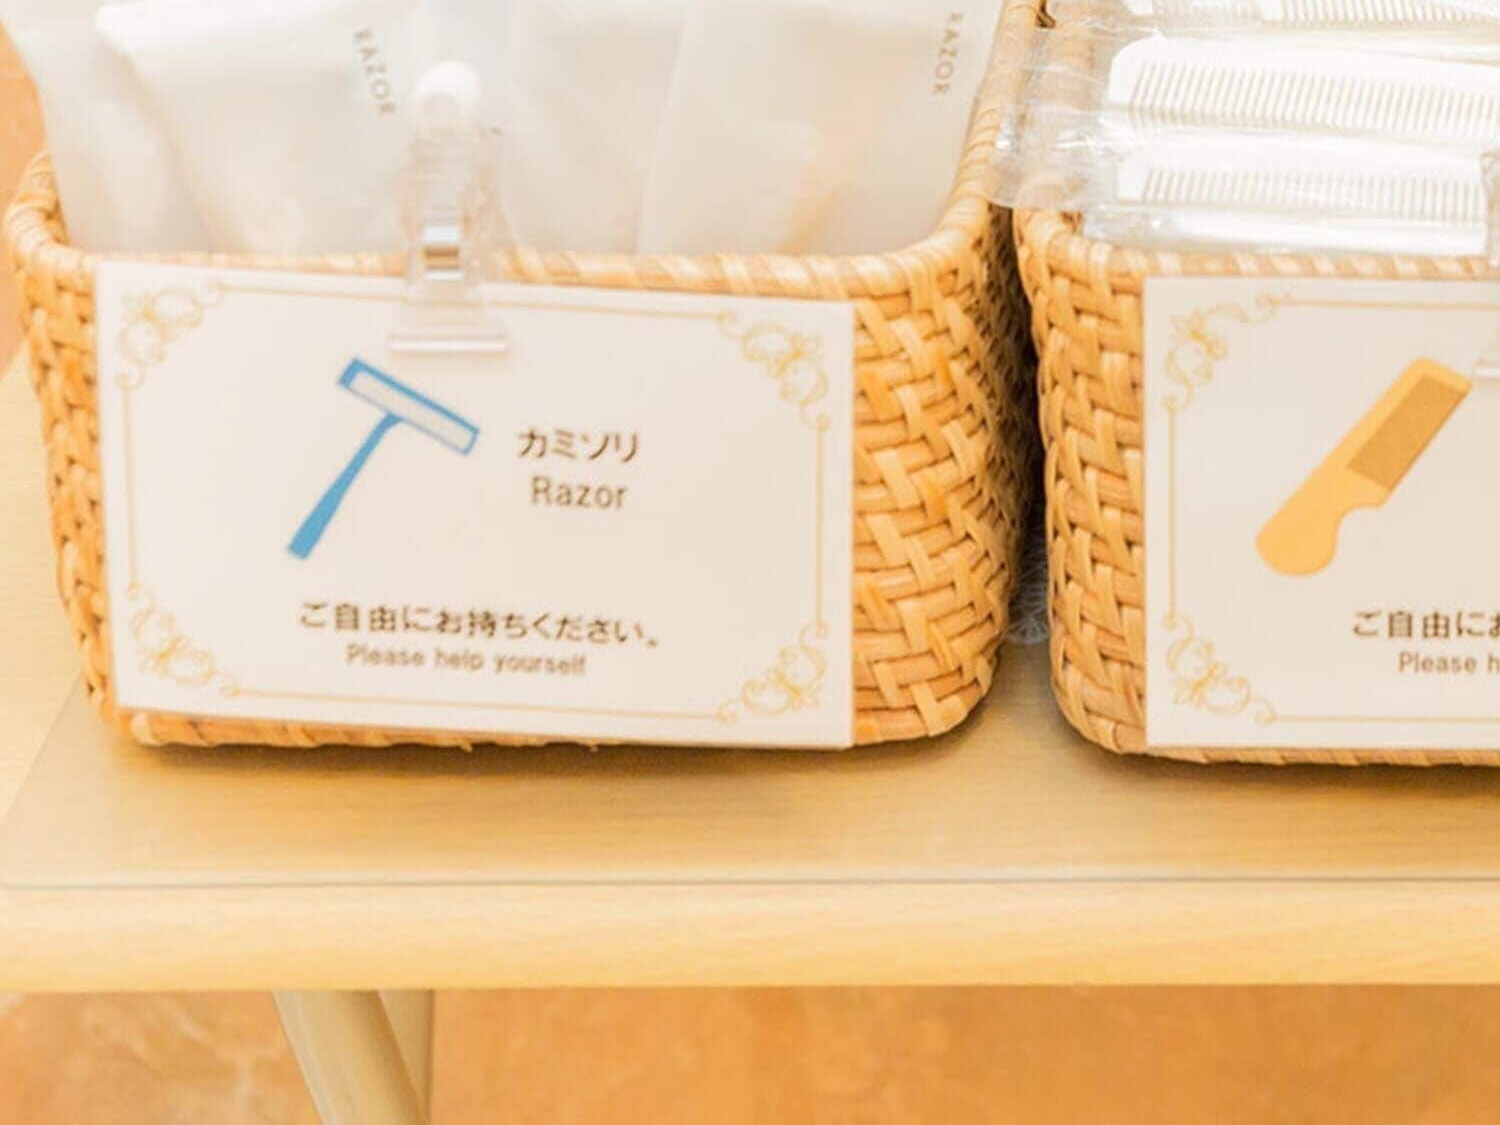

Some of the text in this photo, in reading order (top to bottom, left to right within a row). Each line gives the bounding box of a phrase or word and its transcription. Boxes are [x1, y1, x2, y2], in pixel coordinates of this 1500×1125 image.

[353, 28, 396, 115] RAZOR
[934, 12, 963, 93] RAZOR
[518, 427, 639, 465] カミソリ
[531, 474, 628, 511] Razor
[301, 602, 660, 647] ご自由にお持ちください。
[346, 643, 587, 677] Please help yourself
[1398, 650, 1478, 675] Please
